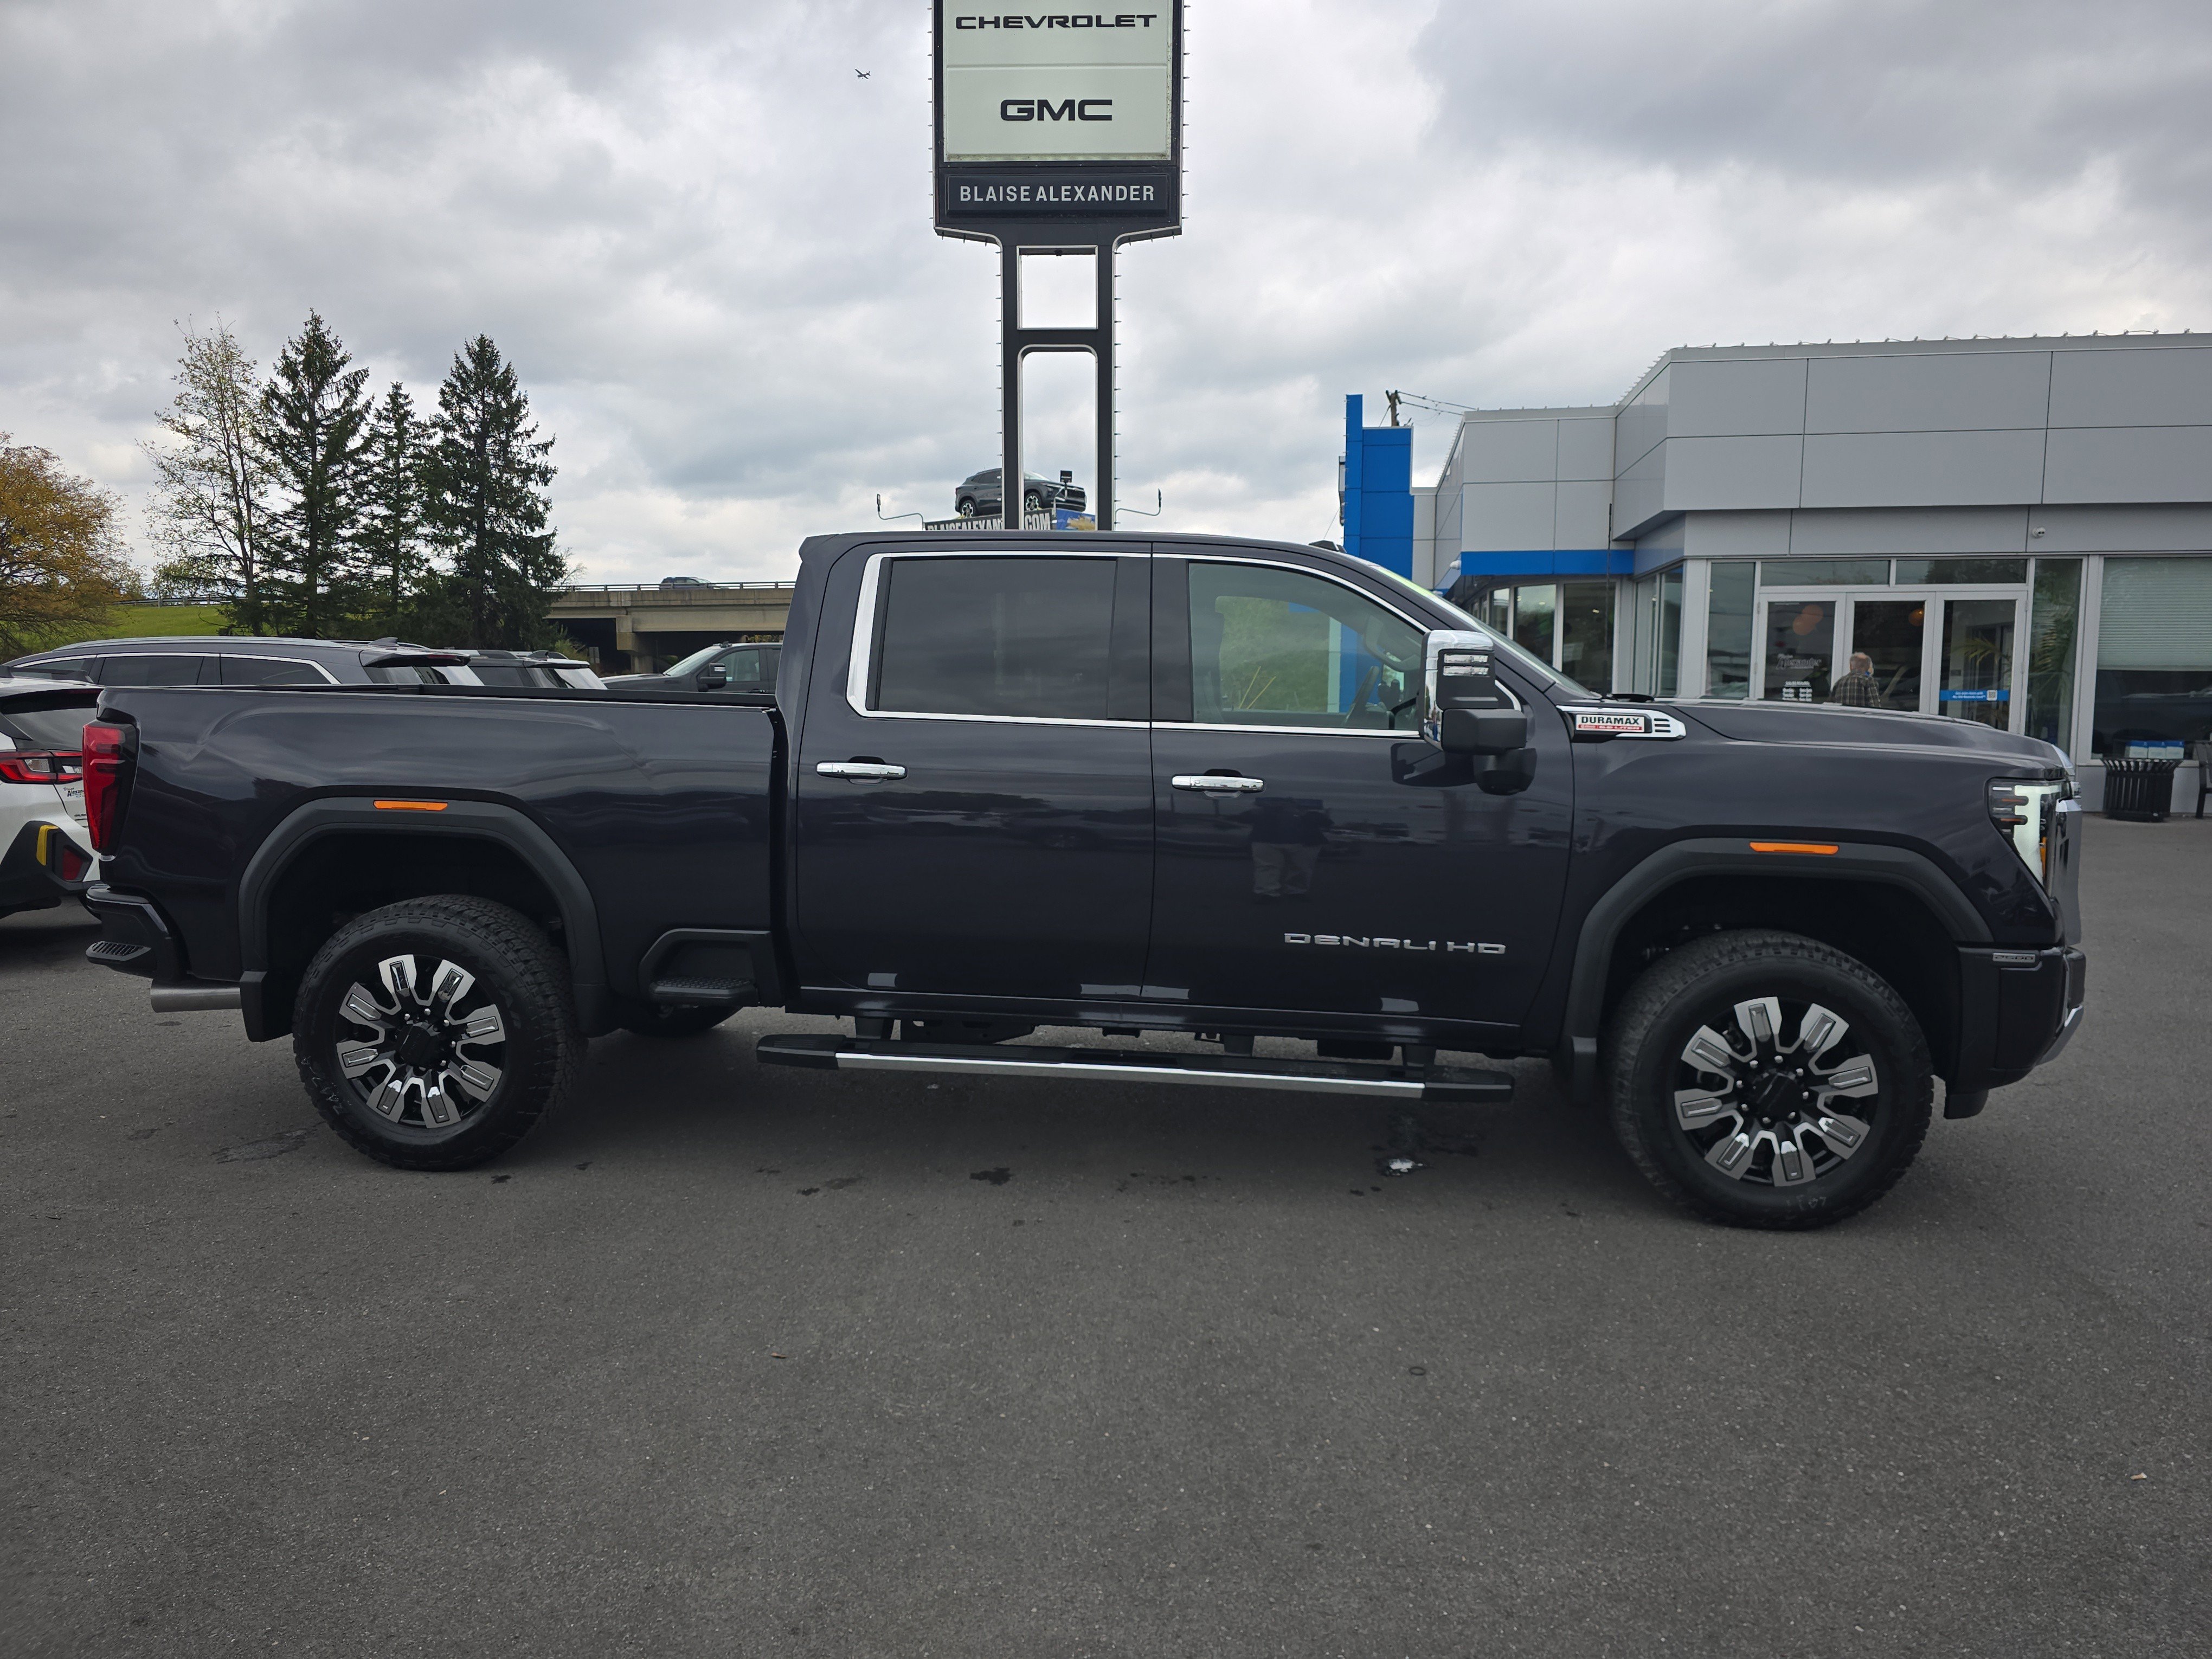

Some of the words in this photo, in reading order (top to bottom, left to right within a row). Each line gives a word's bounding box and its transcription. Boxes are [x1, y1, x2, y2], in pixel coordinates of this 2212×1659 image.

[956, 15, 1157, 29] CHEVROLET
[1000, 99, 1112, 121] GMC
[960, 185, 1031, 202] BLAISE
[1036, 185, 1155, 201] ALEXANDER
[1581, 716, 1639, 725] DURAMAX
[1284, 933, 1436, 950] DENALI
[1447, 941, 1507, 954] HD
